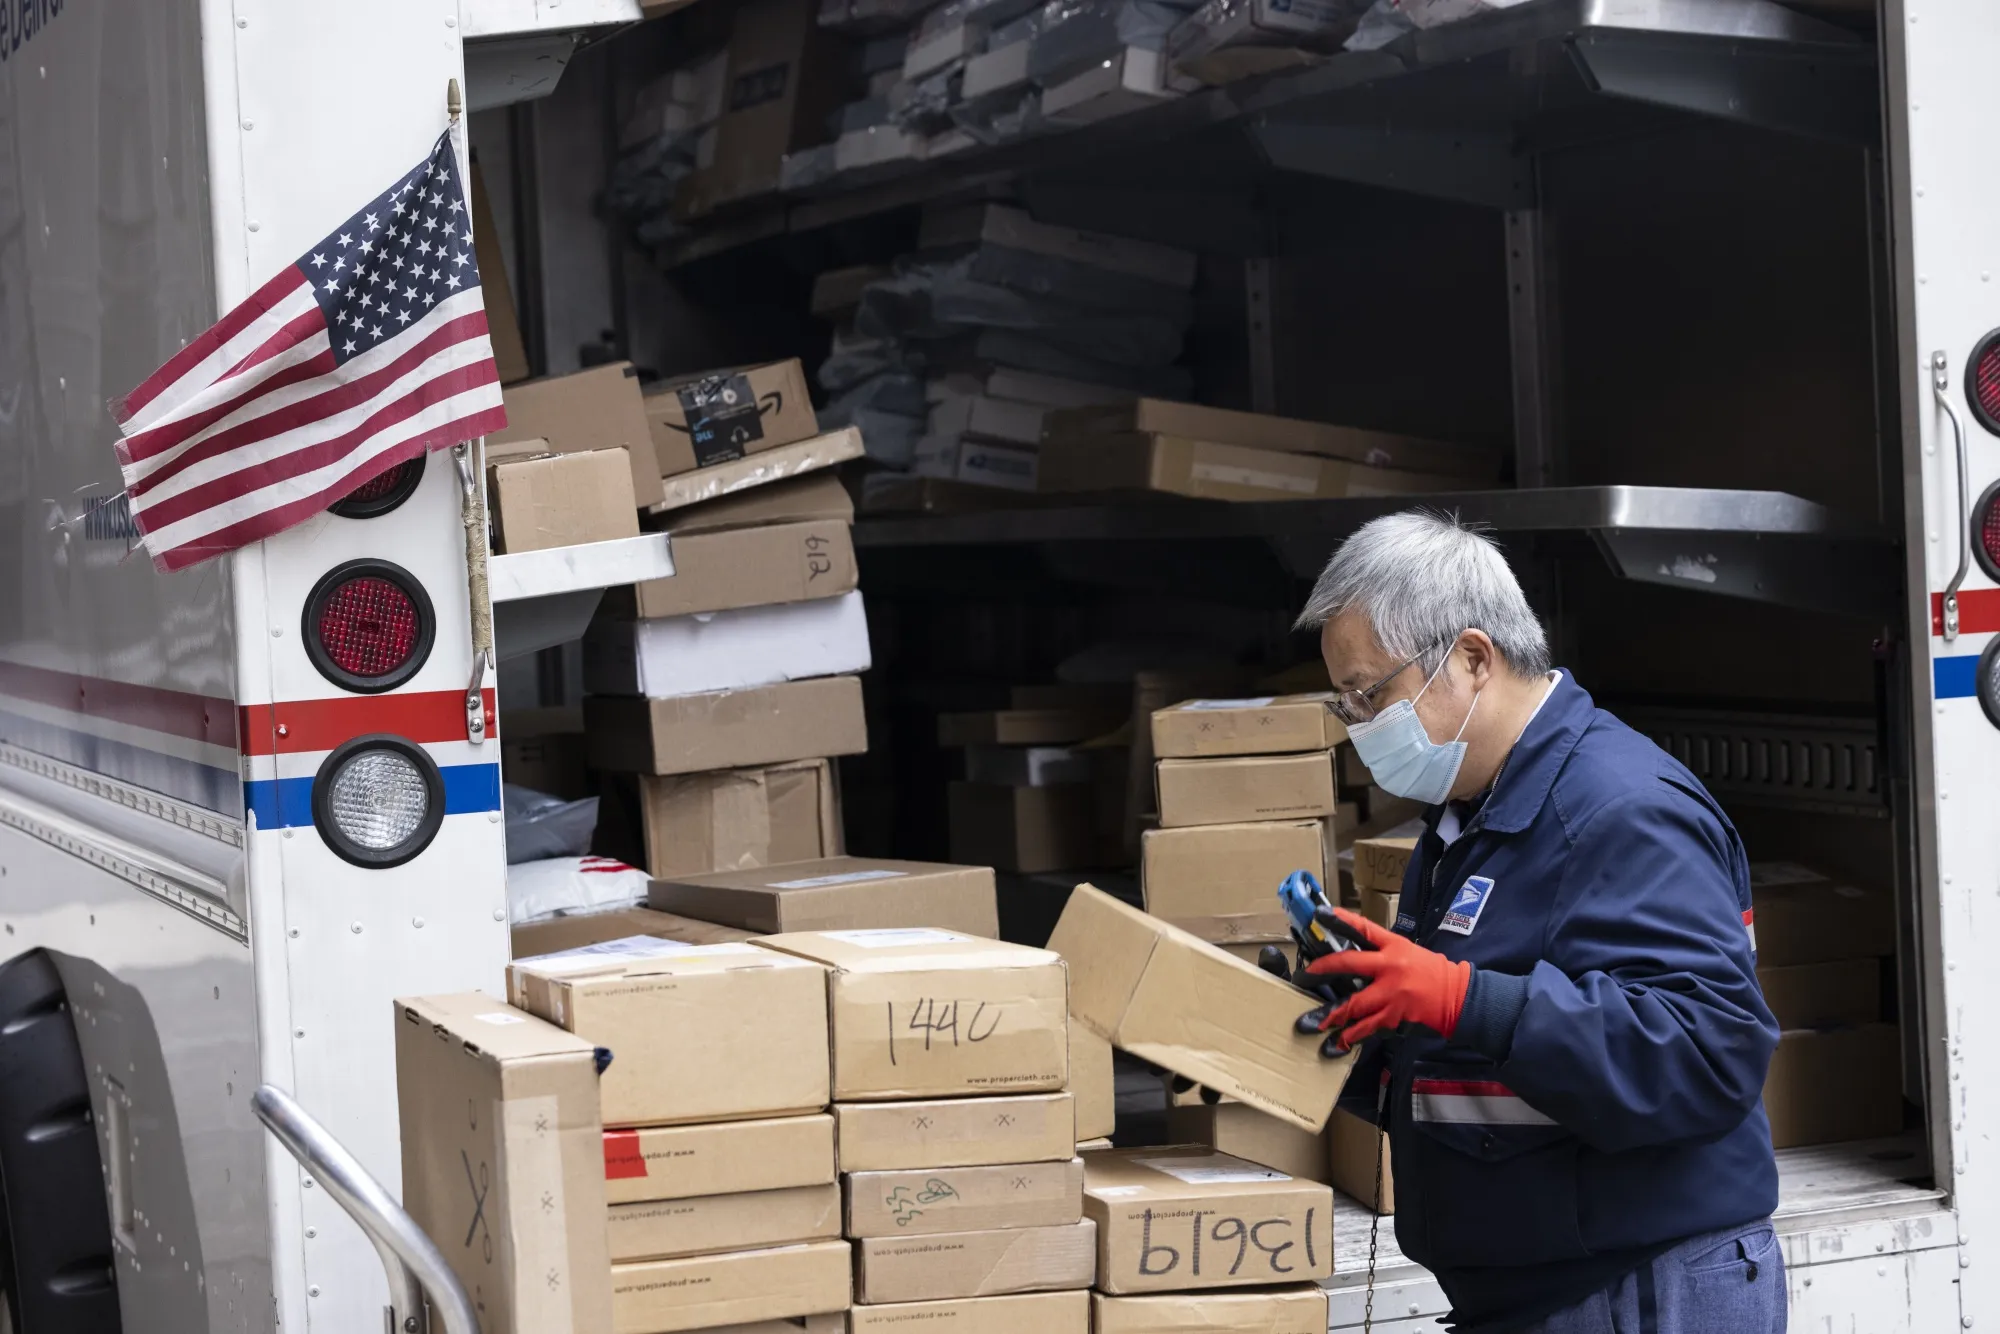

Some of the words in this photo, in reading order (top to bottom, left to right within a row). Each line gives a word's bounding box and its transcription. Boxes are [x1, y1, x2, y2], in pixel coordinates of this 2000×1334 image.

[804, 534, 831, 582] 612
[966, 1074, 1059, 1084] www.propercloth.com
[1128, 1209, 1216, 1220] www.properclot.com
[1139, 1207, 1317, 1276] 13619
[874, 1244, 964, 1256] www.propercloth.com
[615, 1277, 711, 1293] www.propercloth.com
[865, 1311, 957, 1324] www.propercloth.com
